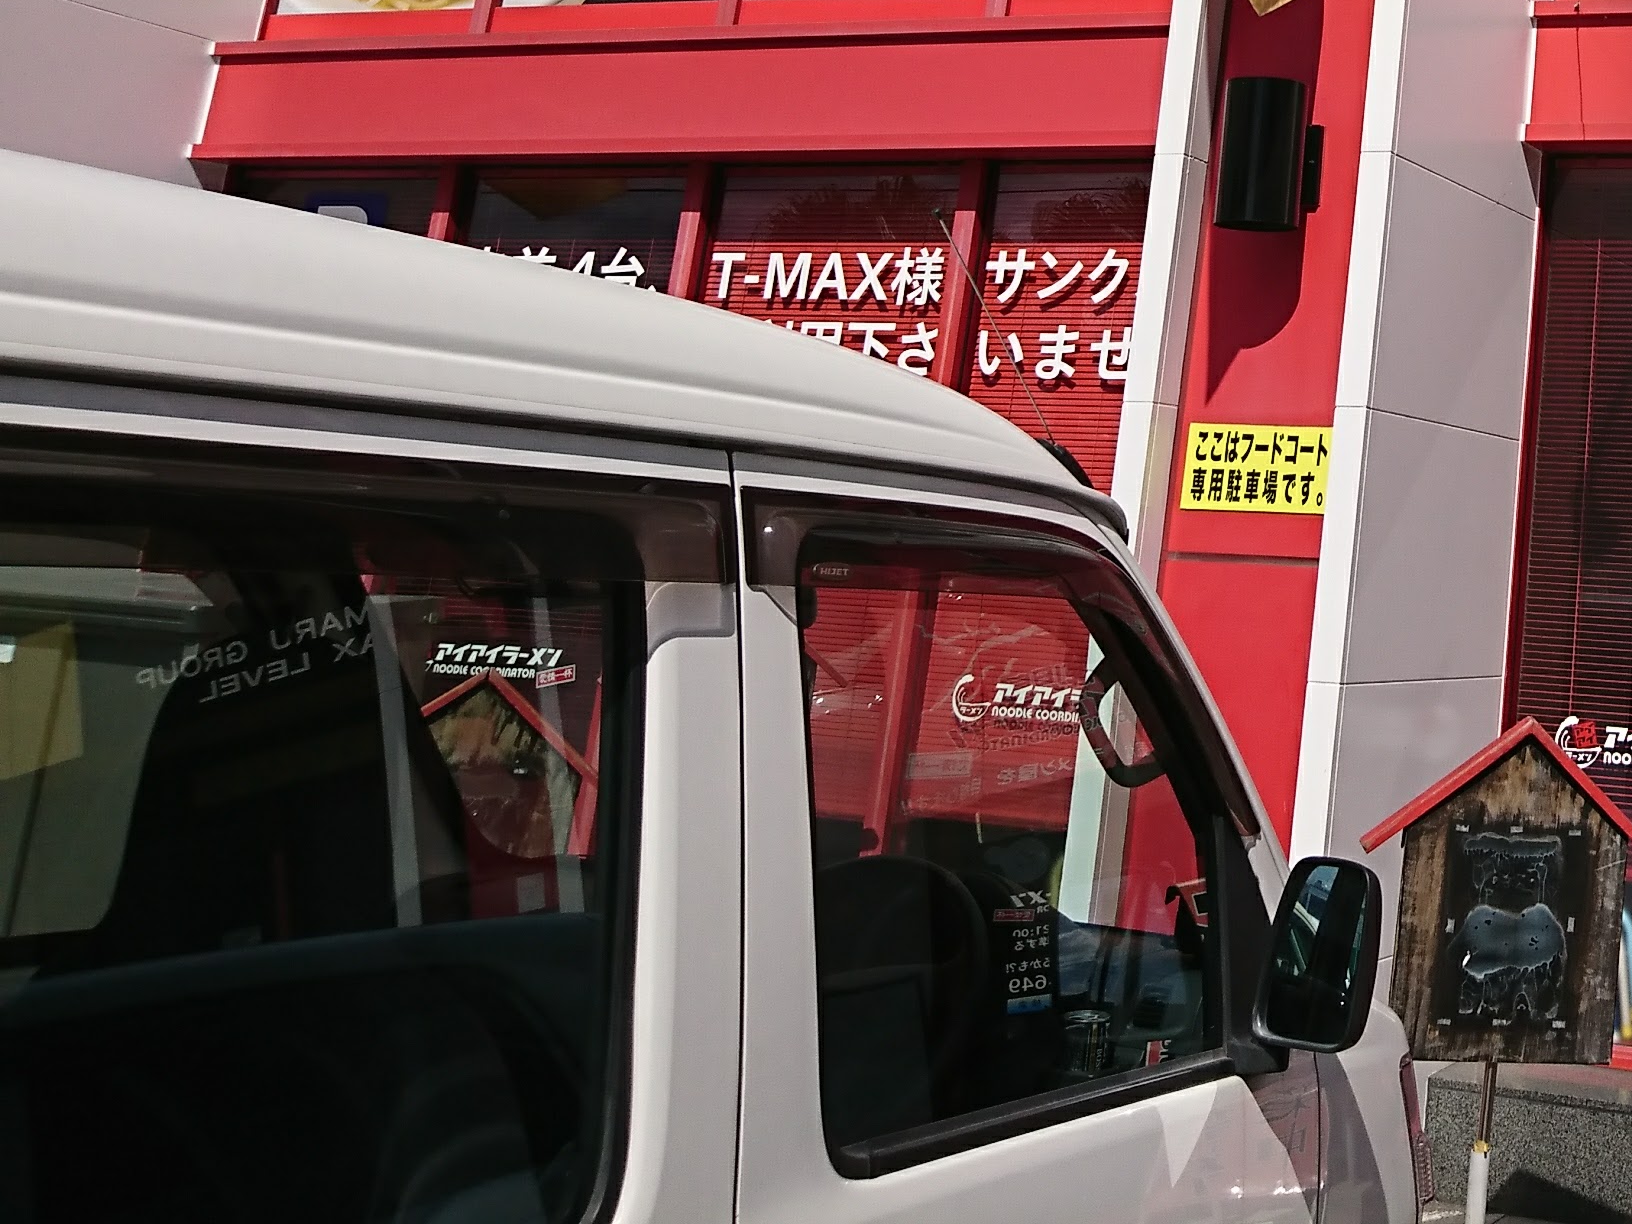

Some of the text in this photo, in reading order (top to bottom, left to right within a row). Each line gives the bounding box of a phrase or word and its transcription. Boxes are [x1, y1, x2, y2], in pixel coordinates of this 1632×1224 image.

[712, 246, 945, 306] T-MAX様
[985, 248, 1139, 304] サンク
[1195, 431, 1329, 467] ここはフードコート
[1190, 467, 1324, 507] 専用駐車場です。
[433, 663, 469, 676] NOODLE
[435, 643, 564, 668] アイアイラーメン
[991, 705, 1033, 719] NOODLE
